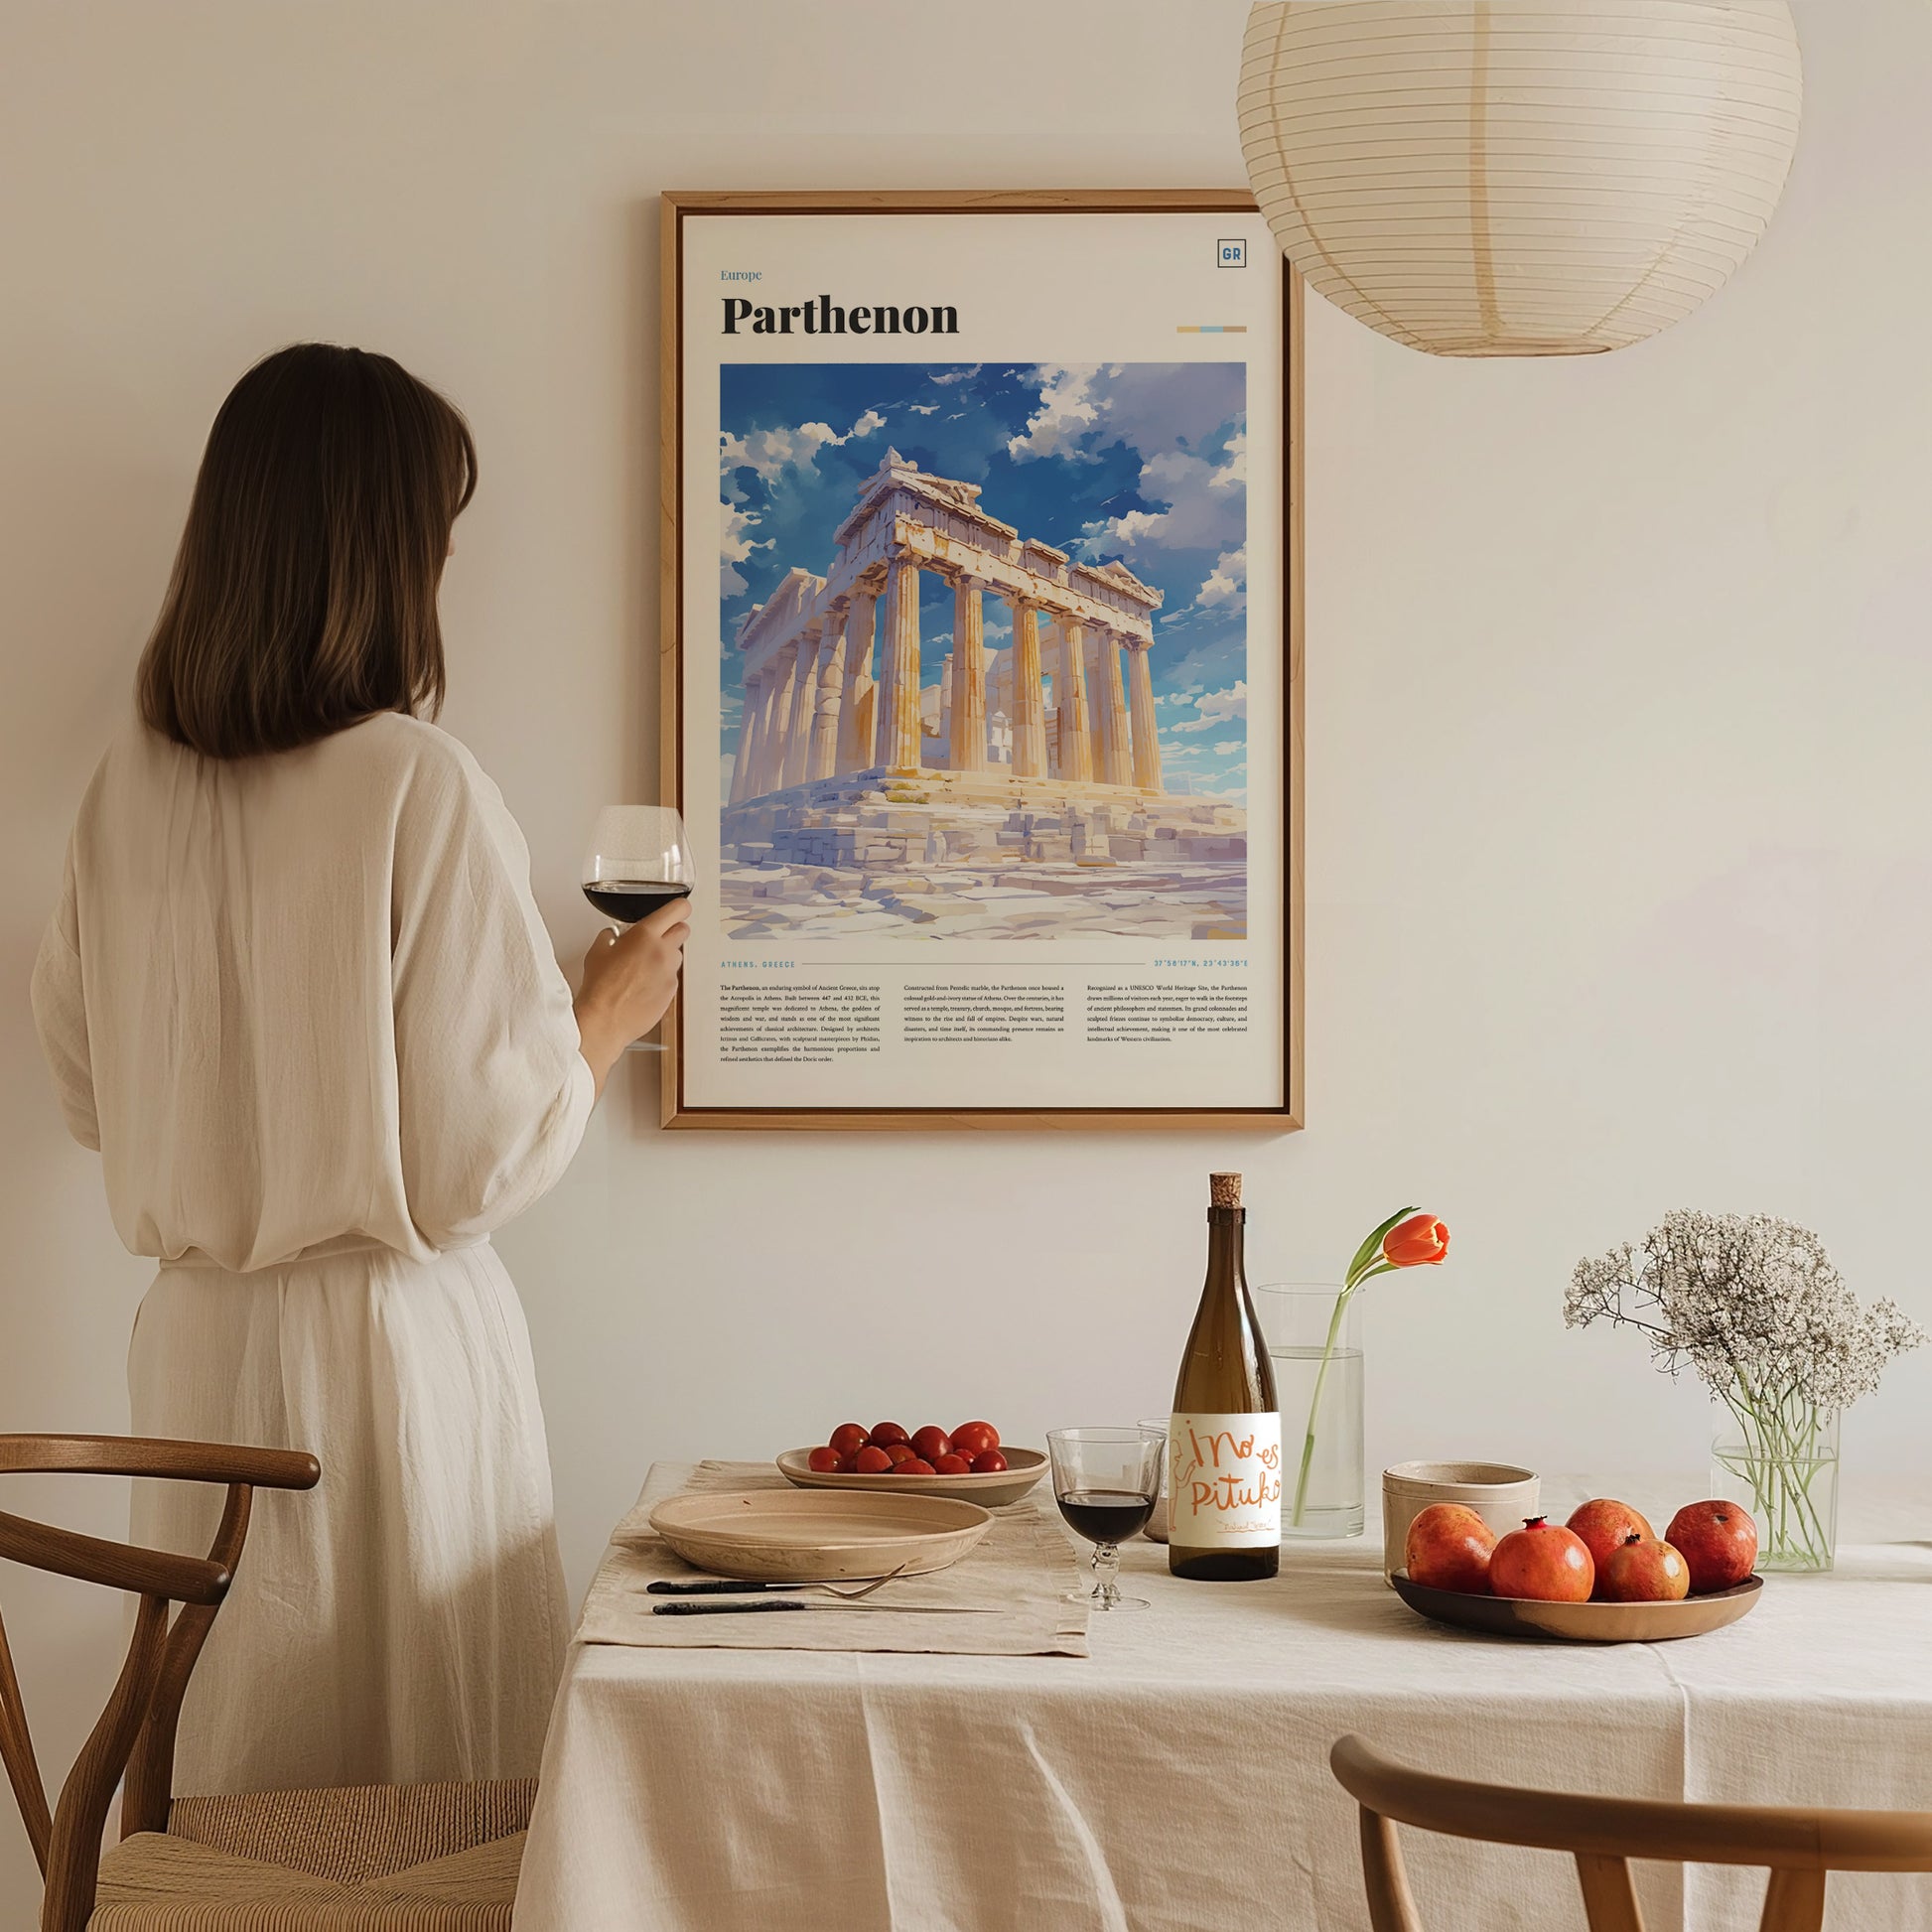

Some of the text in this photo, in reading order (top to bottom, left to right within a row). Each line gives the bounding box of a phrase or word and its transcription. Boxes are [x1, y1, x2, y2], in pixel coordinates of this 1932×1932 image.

[1222, 247, 1241, 260] GR
[721, 270, 762, 282] Europe
[721, 294, 960, 335] Parthenon
[852, 1035, 859, 1044] by
